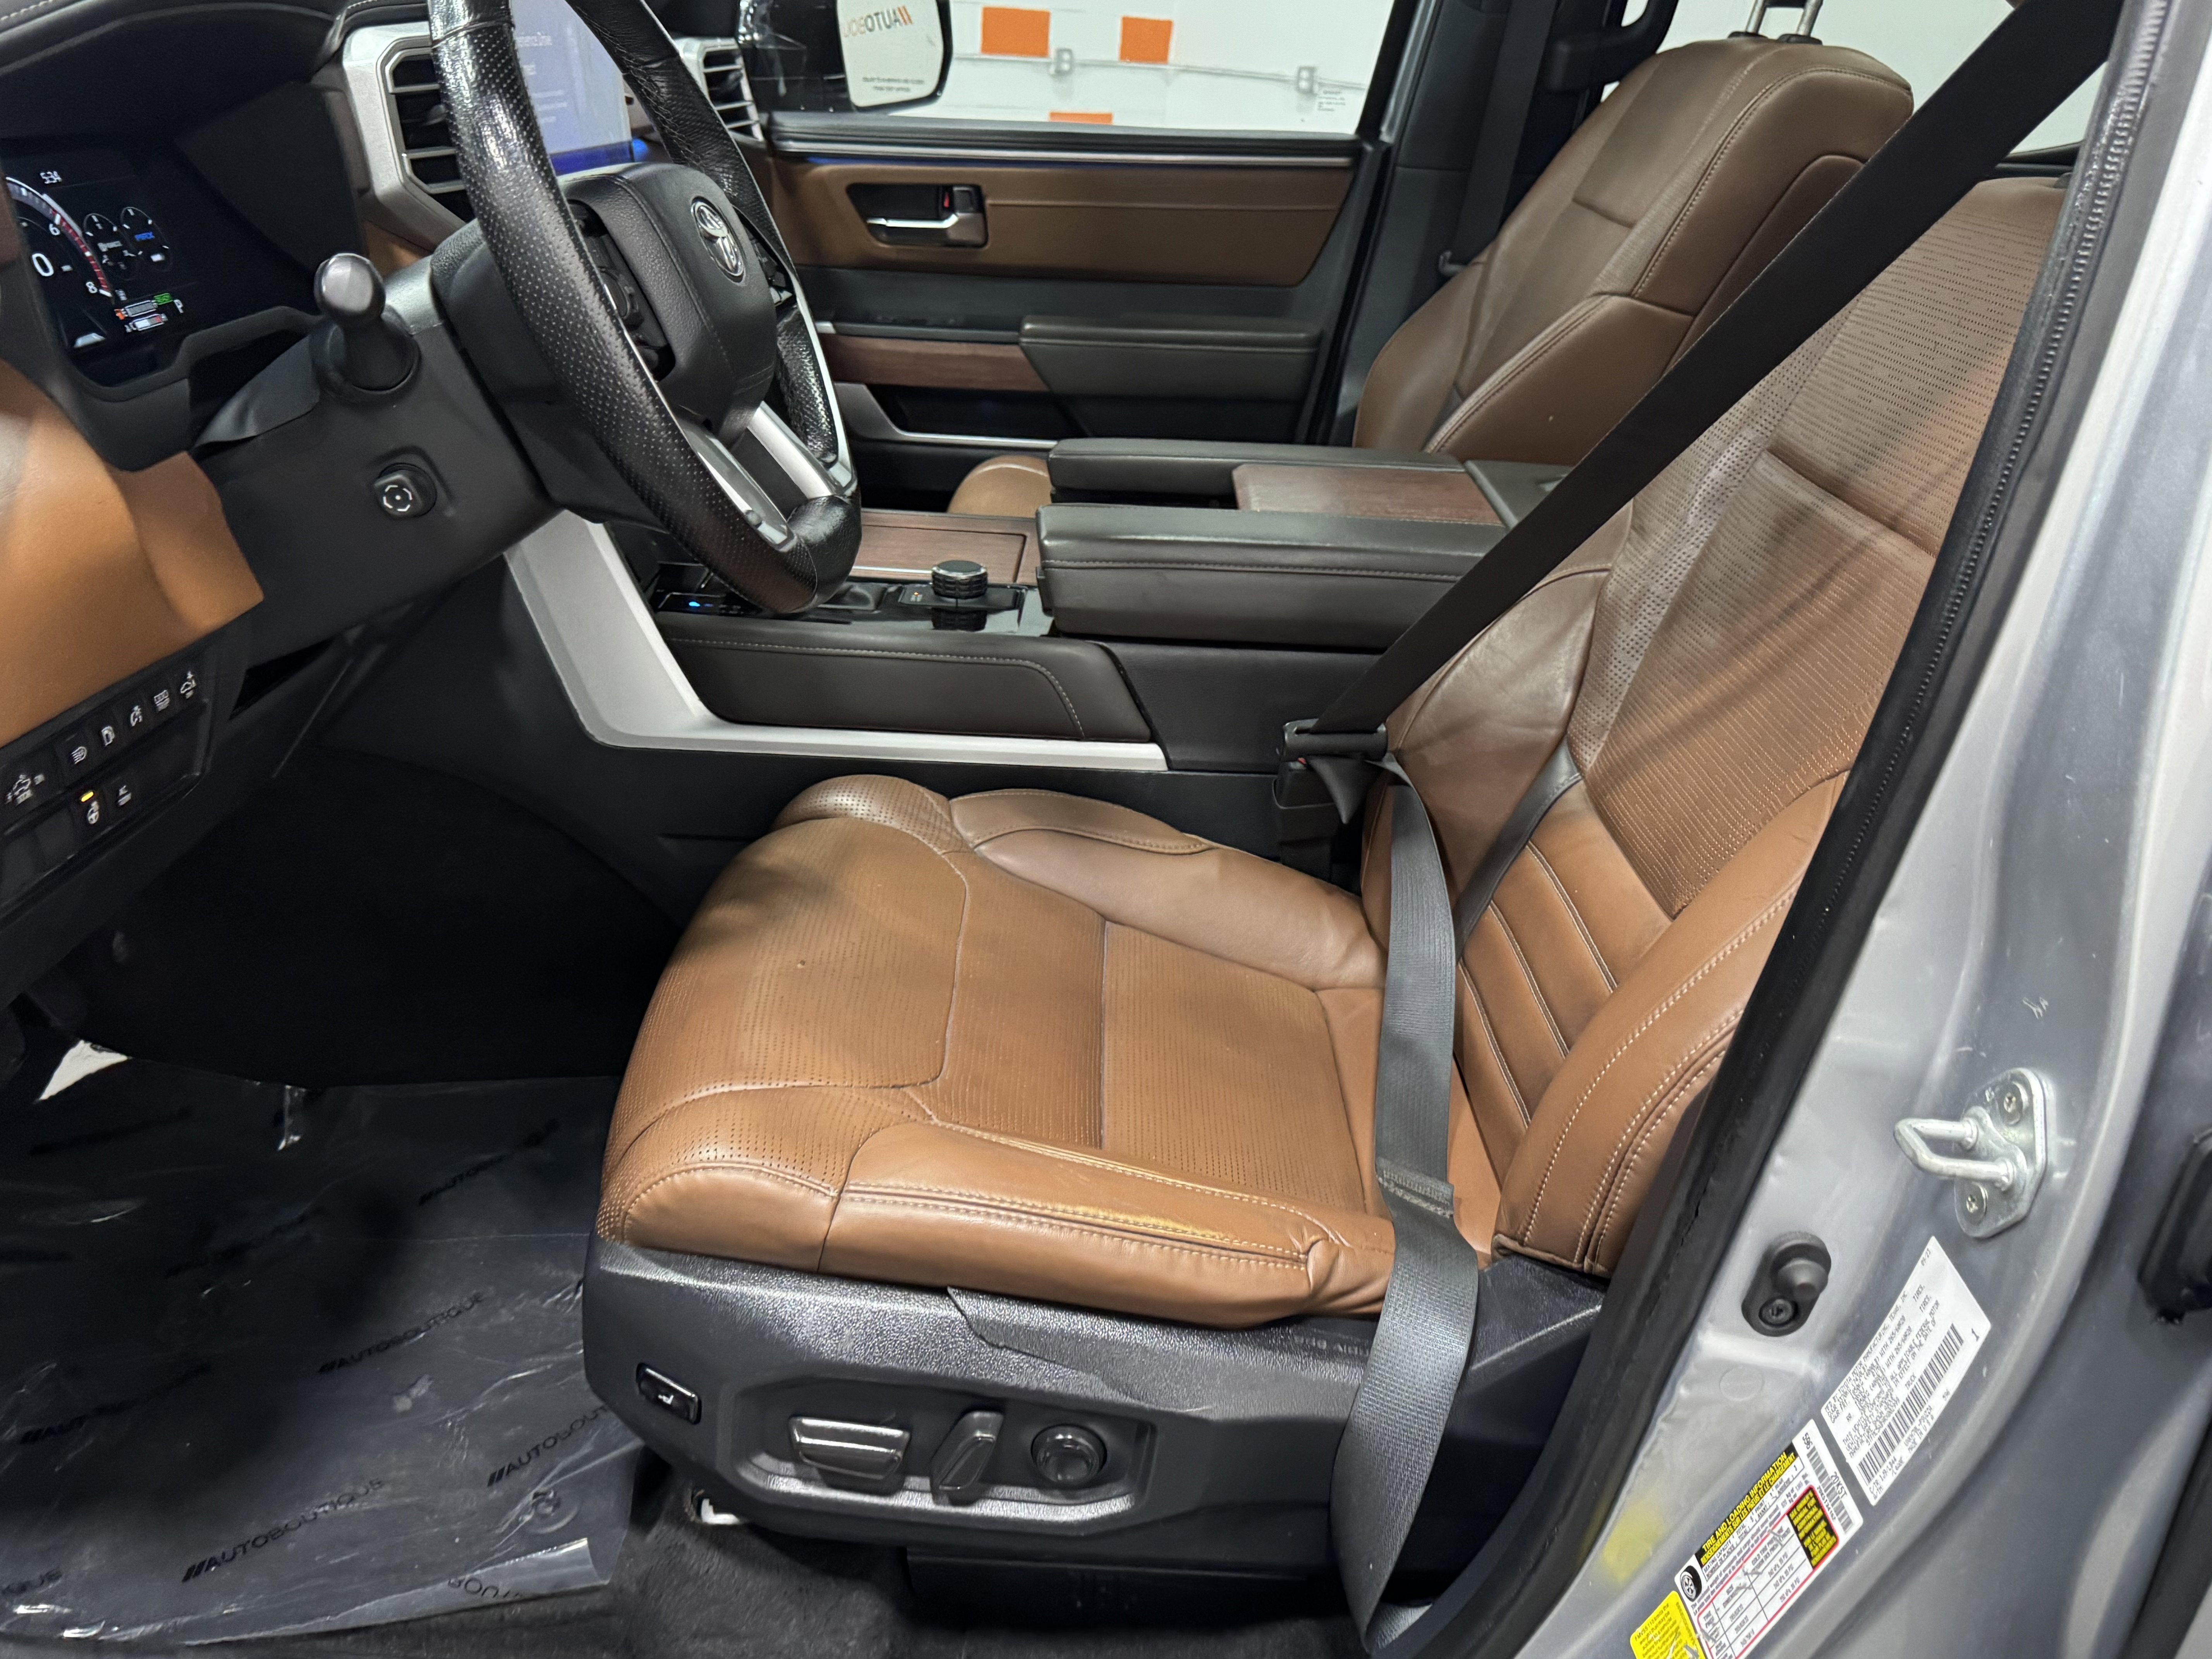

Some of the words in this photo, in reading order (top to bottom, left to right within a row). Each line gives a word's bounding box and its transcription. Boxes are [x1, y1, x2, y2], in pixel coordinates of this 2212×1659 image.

[49, 223, 60, 235] 6
[32, 253, 53, 276] 0
[86, 282, 97, 293] 8
[1904, 1371, 1916, 1390] TRUCK
[1731, 1515, 1741, 1530] SUR
[1739, 1507, 1748, 1521] LES
[1758, 1487, 1765, 1498] ET
[1763, 1480, 1771, 1492] LE
[1768, 1451, 1796, 1486] CHARGEMENT
[1702, 1534, 1716, 1553] TIRE
[1714, 1520, 1728, 1539] AND
[1726, 1493, 1751, 1526] LOADING
[1748, 1451, 1788, 1498] INFORMATION
[1716, 1539, 1732, 1559] CAPACITY
